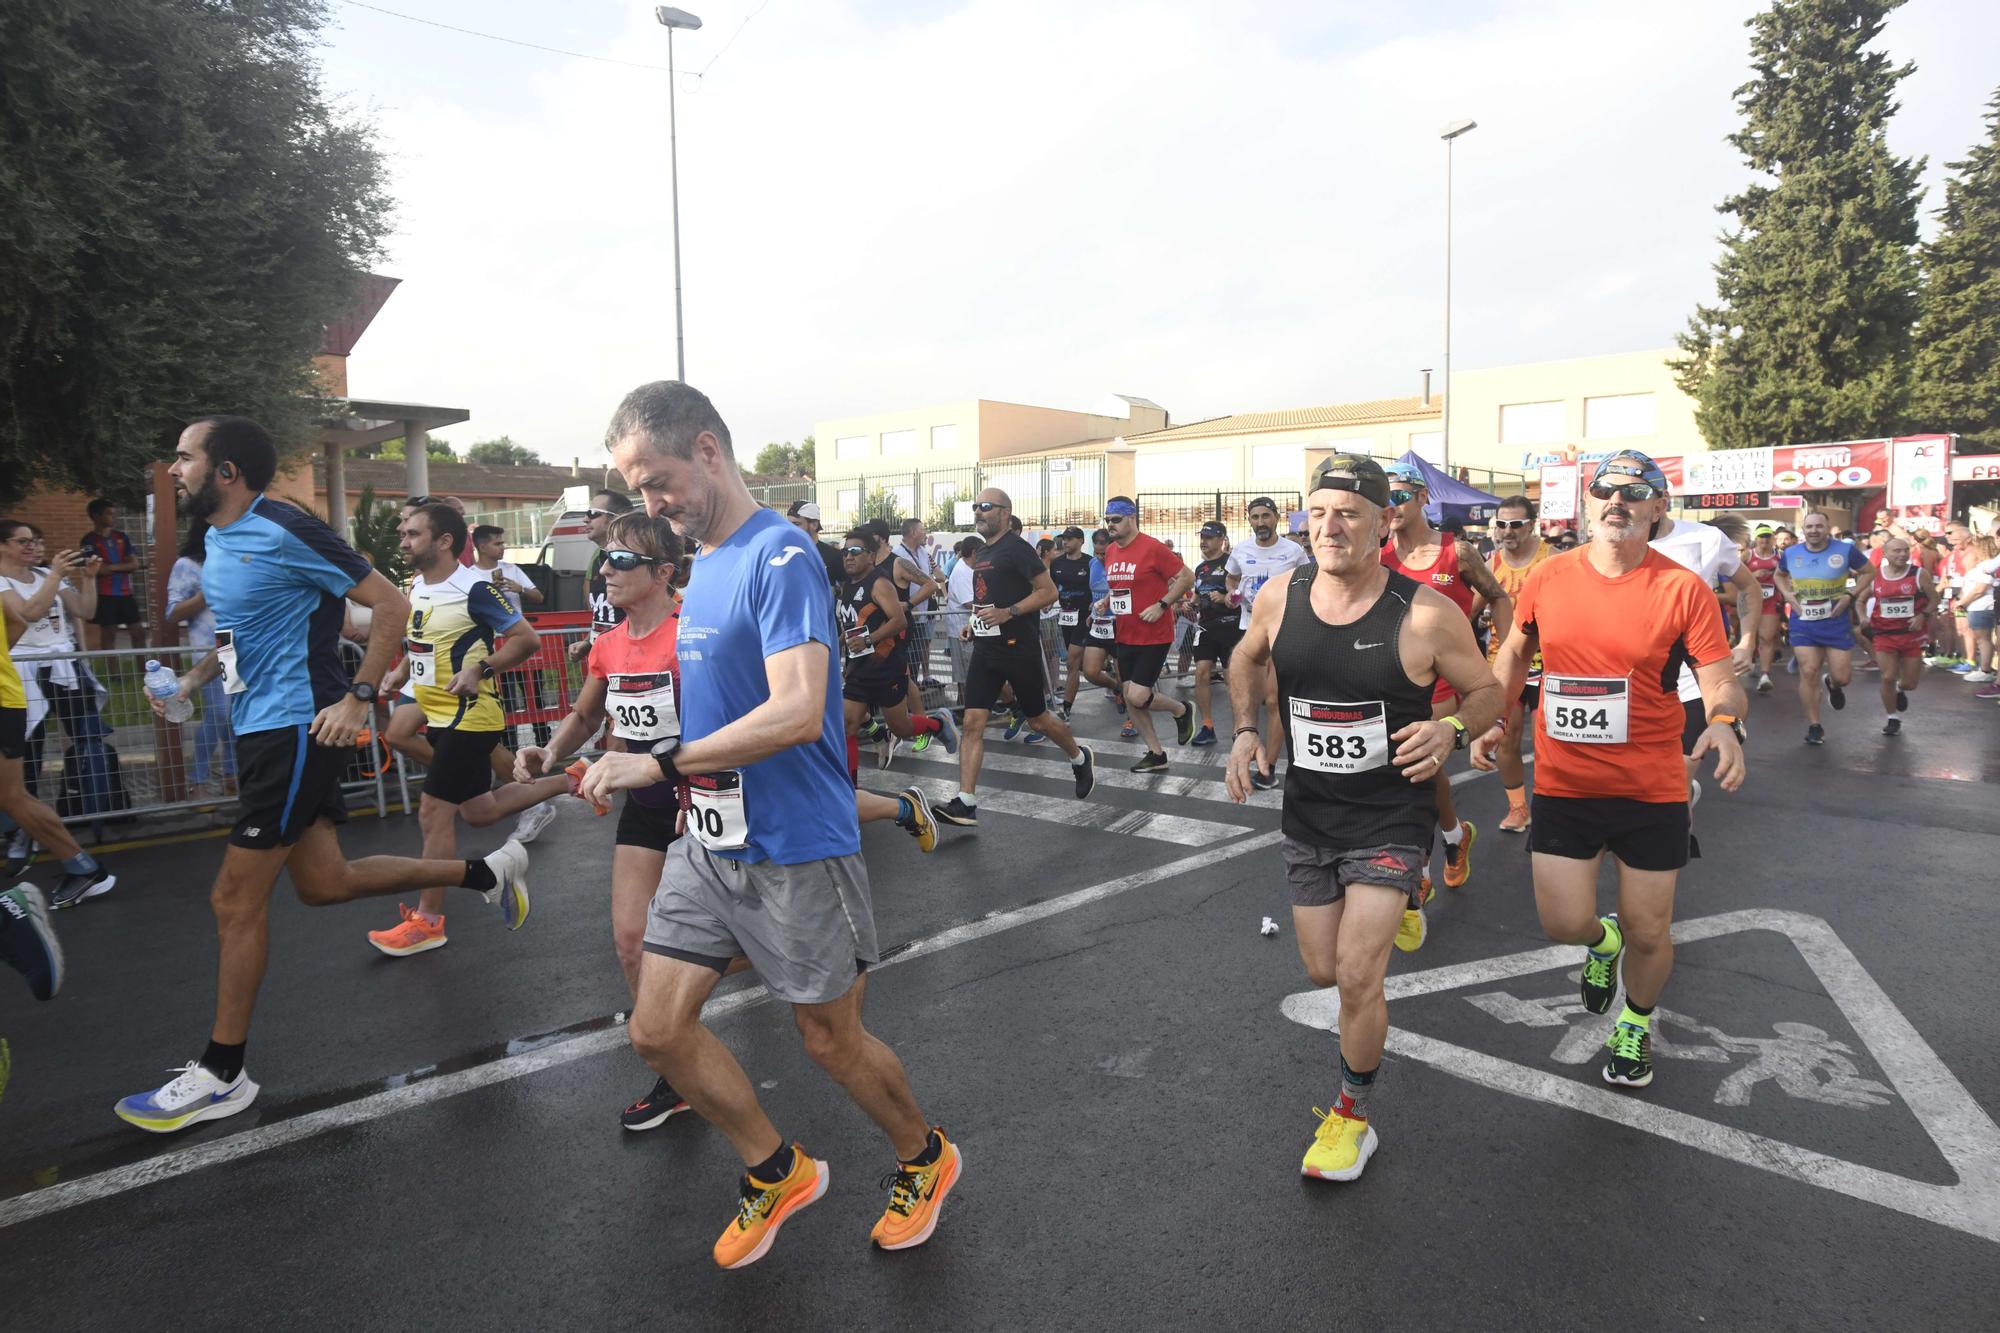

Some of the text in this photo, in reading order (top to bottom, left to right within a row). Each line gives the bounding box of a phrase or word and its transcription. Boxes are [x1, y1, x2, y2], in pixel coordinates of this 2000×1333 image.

[1701, 493, 1760, 507] 0:00:15
[486, 584, 514, 615] TOTANA
[1887, 605, 1909, 614] 592
[616, 705, 658, 728] 303
[1555, 706, 1609, 730] 584
[1307, 733, 1368, 759] 583
[1320, 761, 1343, 769] PARRA
